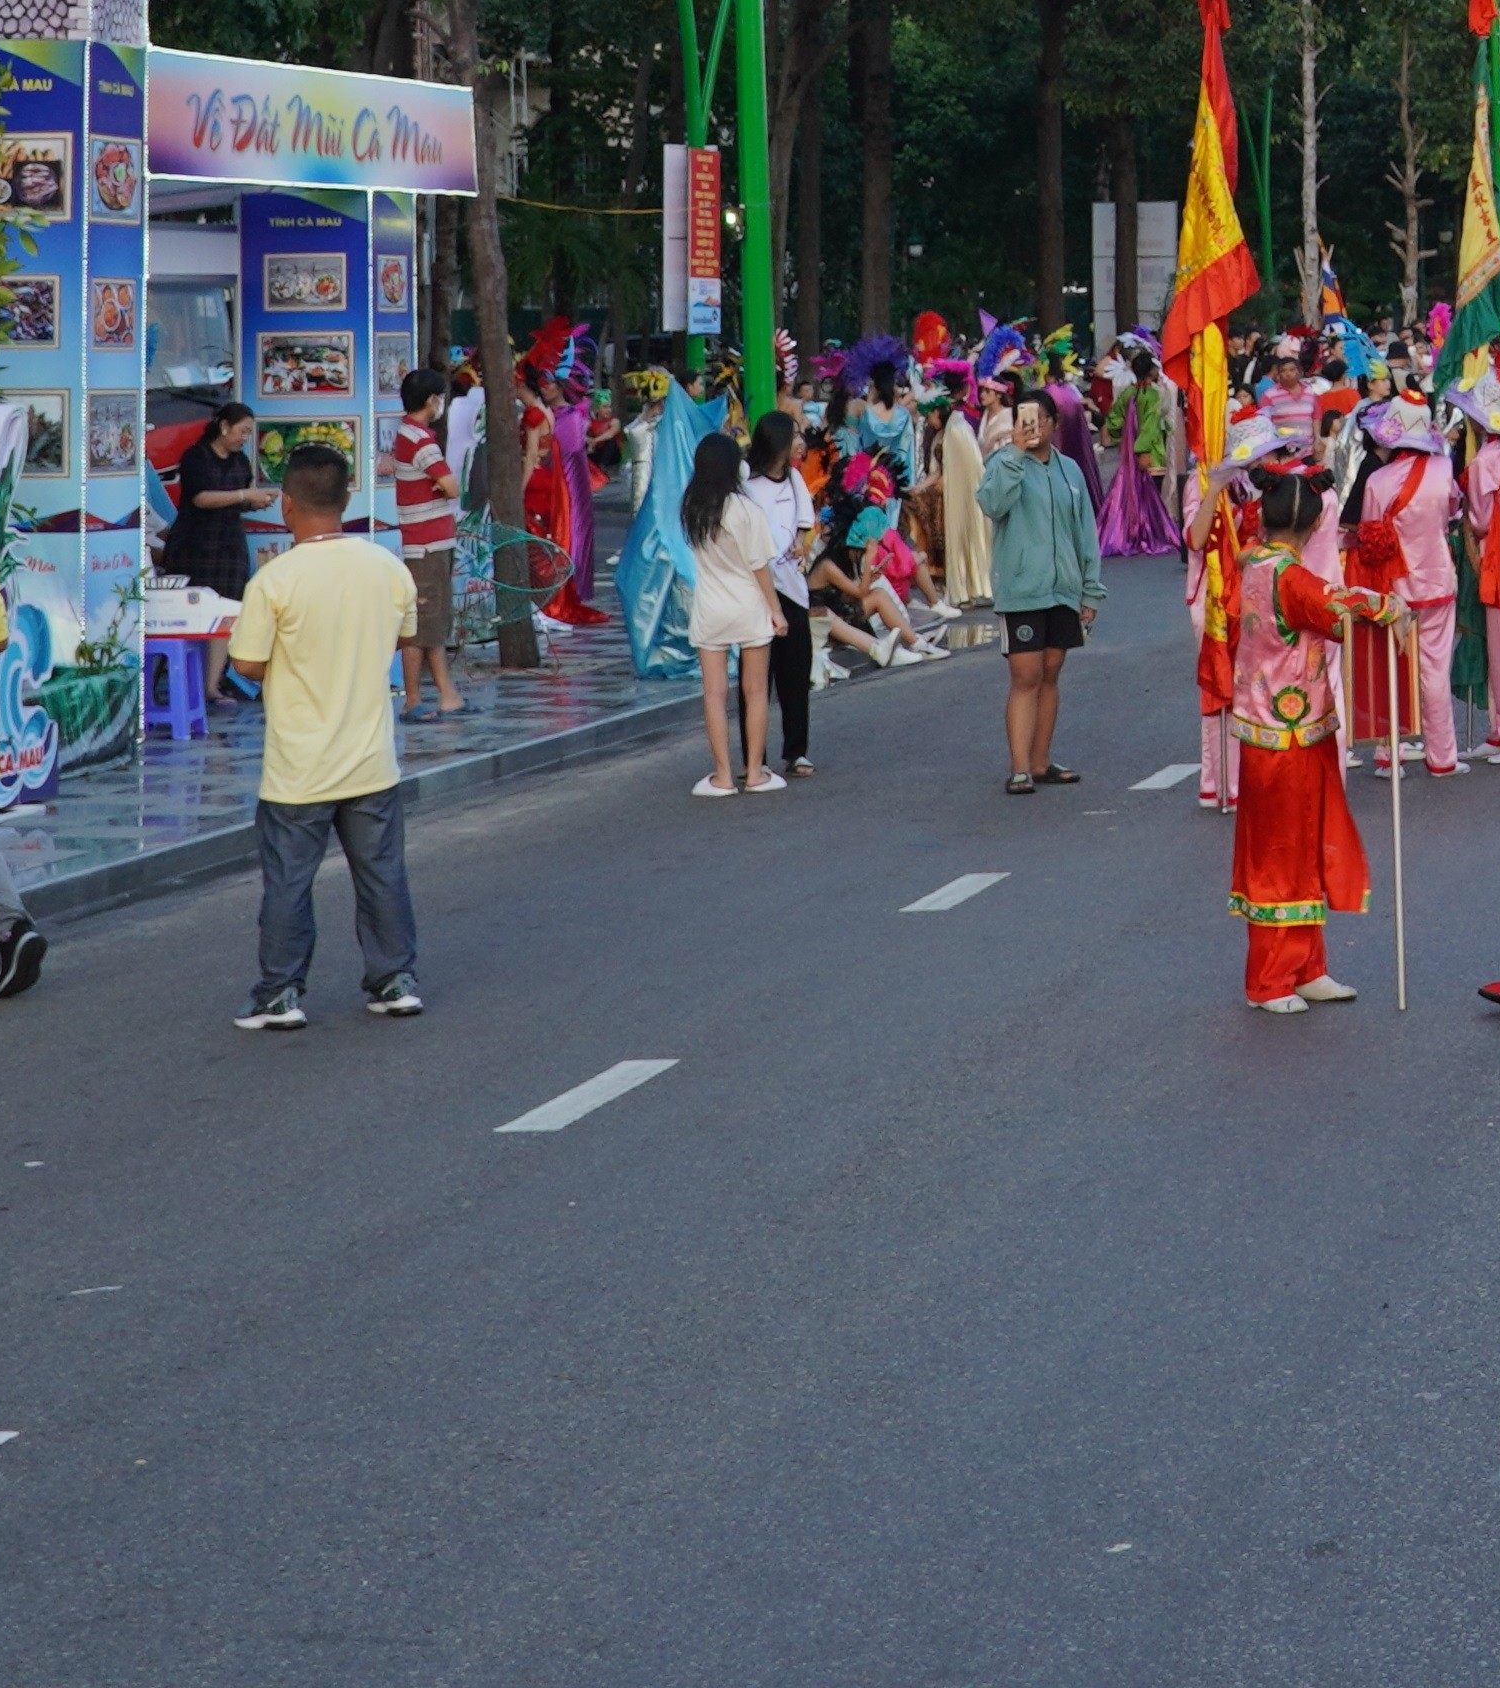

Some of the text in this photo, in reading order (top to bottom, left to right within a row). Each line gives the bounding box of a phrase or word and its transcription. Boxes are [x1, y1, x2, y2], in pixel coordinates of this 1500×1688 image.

[22, 78, 53, 92] MAU
[229, 93, 282, 156] Đất
[286, 93, 345, 159] Mũi
[352, 107, 381, 163] Cà
[386, 104, 443, 166] Mau
[315, 216, 343, 227] MAU
